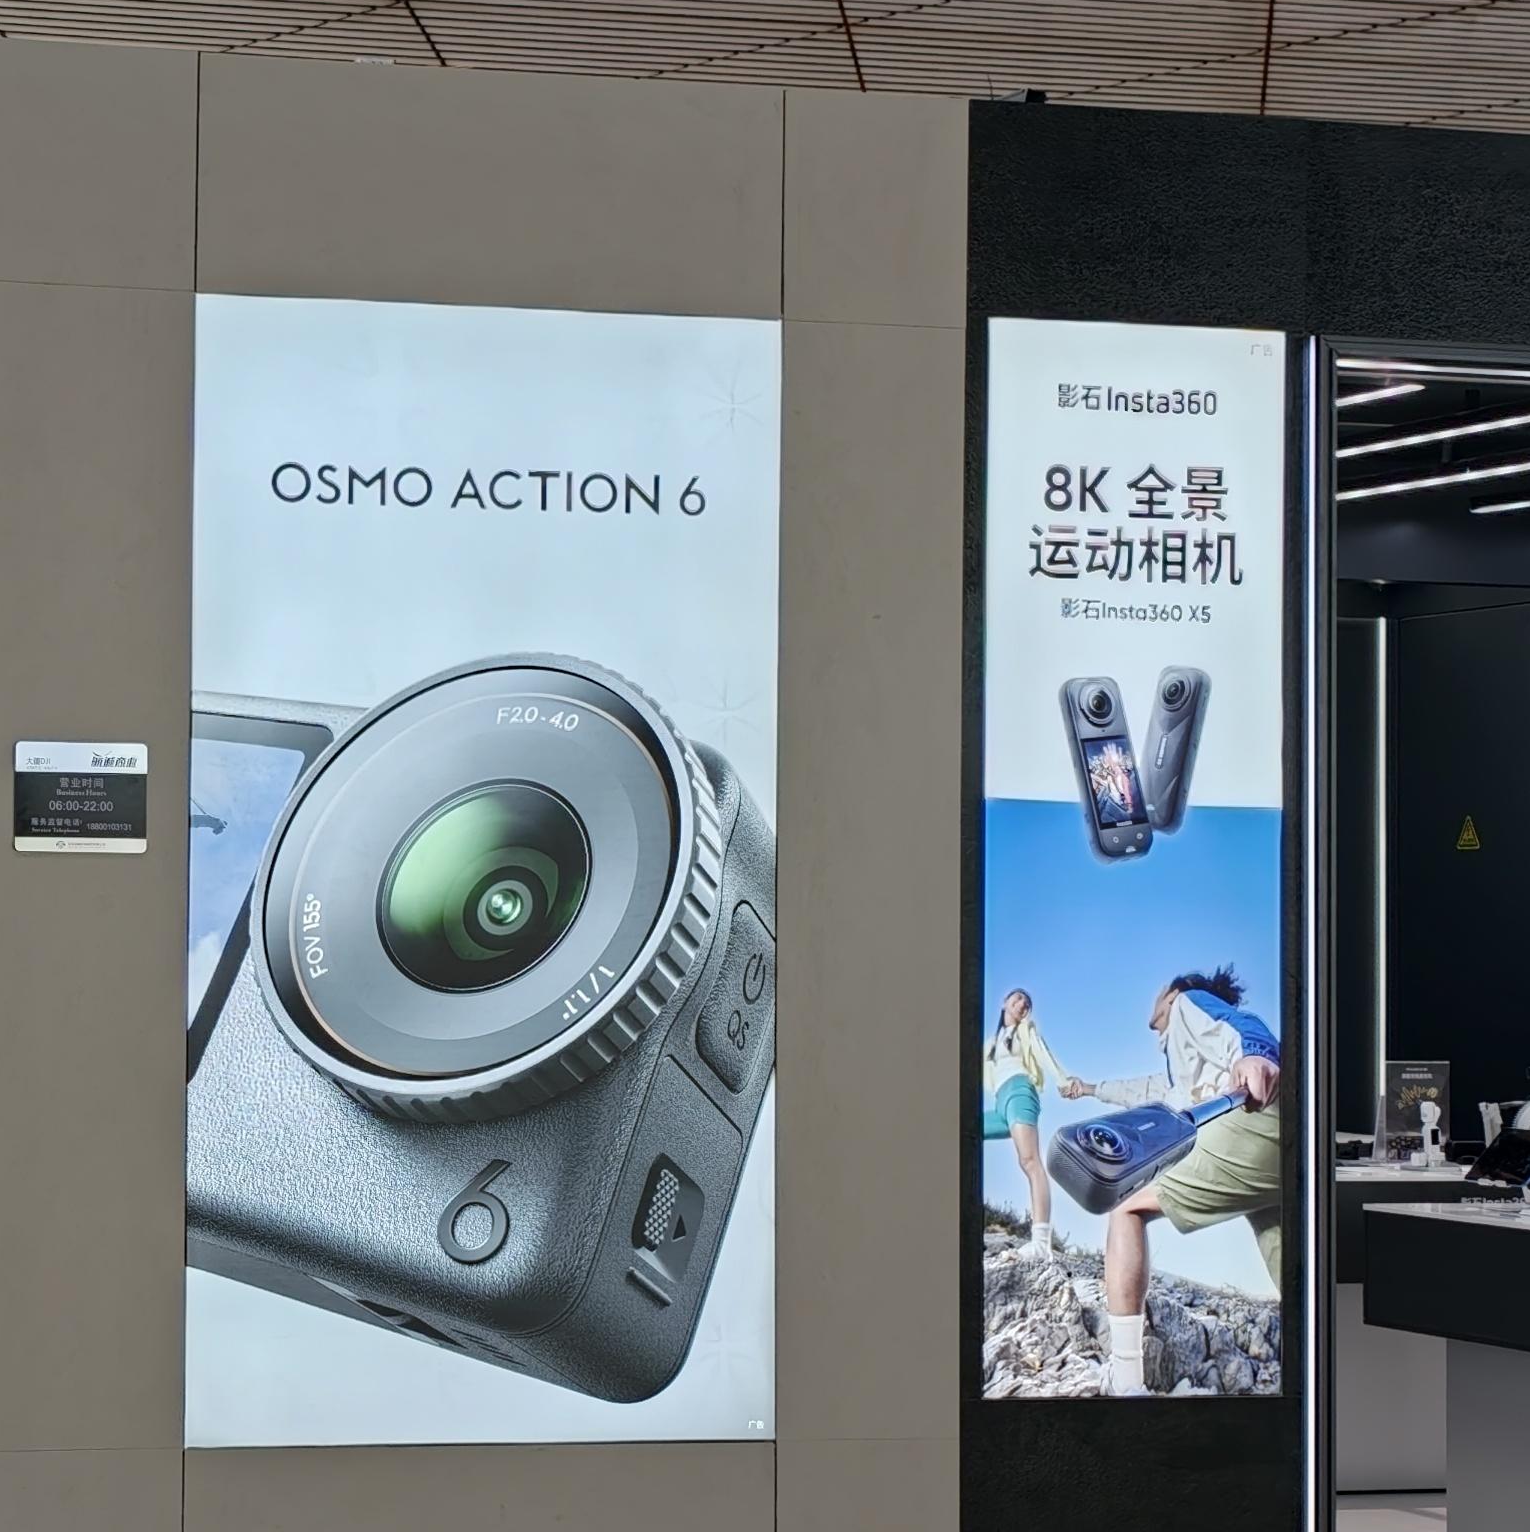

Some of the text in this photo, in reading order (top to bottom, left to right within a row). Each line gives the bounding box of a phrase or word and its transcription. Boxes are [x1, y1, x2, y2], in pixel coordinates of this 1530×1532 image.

[1058, 383, 1218, 415] 影石 Insta360
[271, 461, 706, 516] OSMO ACTION 6
[1044, 464, 1228, 521] 8K 全景
[1029, 524, 1243, 585] 运动相机
[1189, 605, 1212, 623] X5
[60, 777, 104, 789] 营业时间
[49, 800, 114, 812] 06:00-22:00
[303, 936, 329, 979] FOV
[437, 1158, 513, 1264] 6
